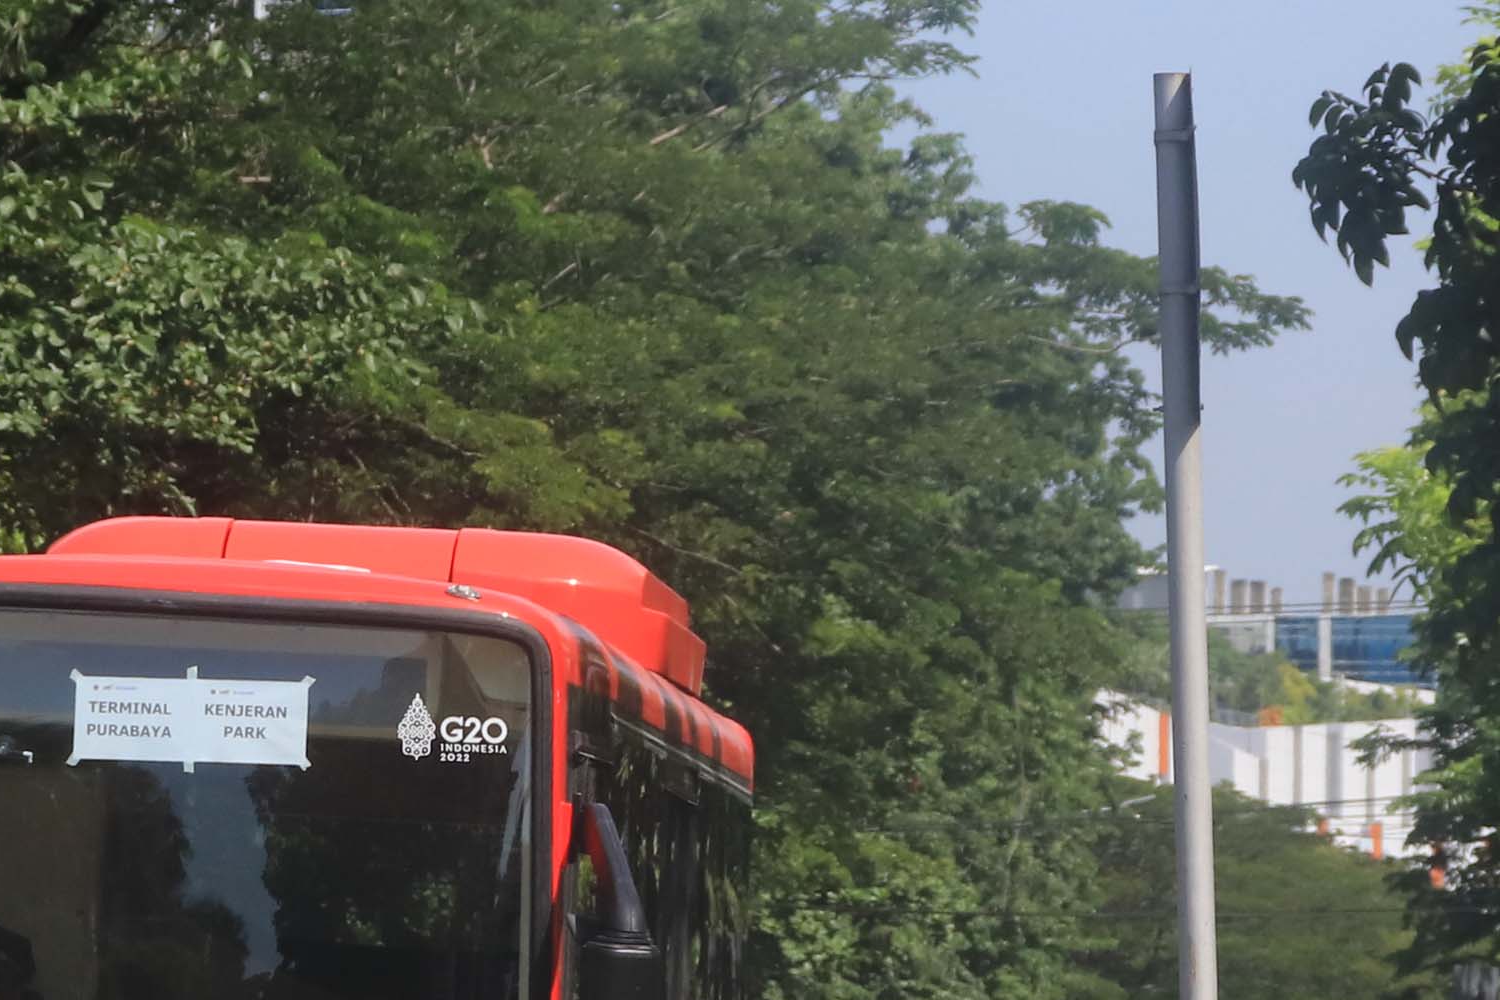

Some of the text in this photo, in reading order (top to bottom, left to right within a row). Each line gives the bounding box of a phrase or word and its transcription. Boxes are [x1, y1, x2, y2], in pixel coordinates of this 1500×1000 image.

[88, 701, 172, 716] TERMINAL
[204, 703, 287, 719] KENJERAN
[86, 723, 172, 739] PURABAYA
[223, 726, 267, 740] PARK
[440, 716, 508, 744] G20
[440, 743, 508, 754] INDONESIA
[440, 753, 470, 762] 2022
